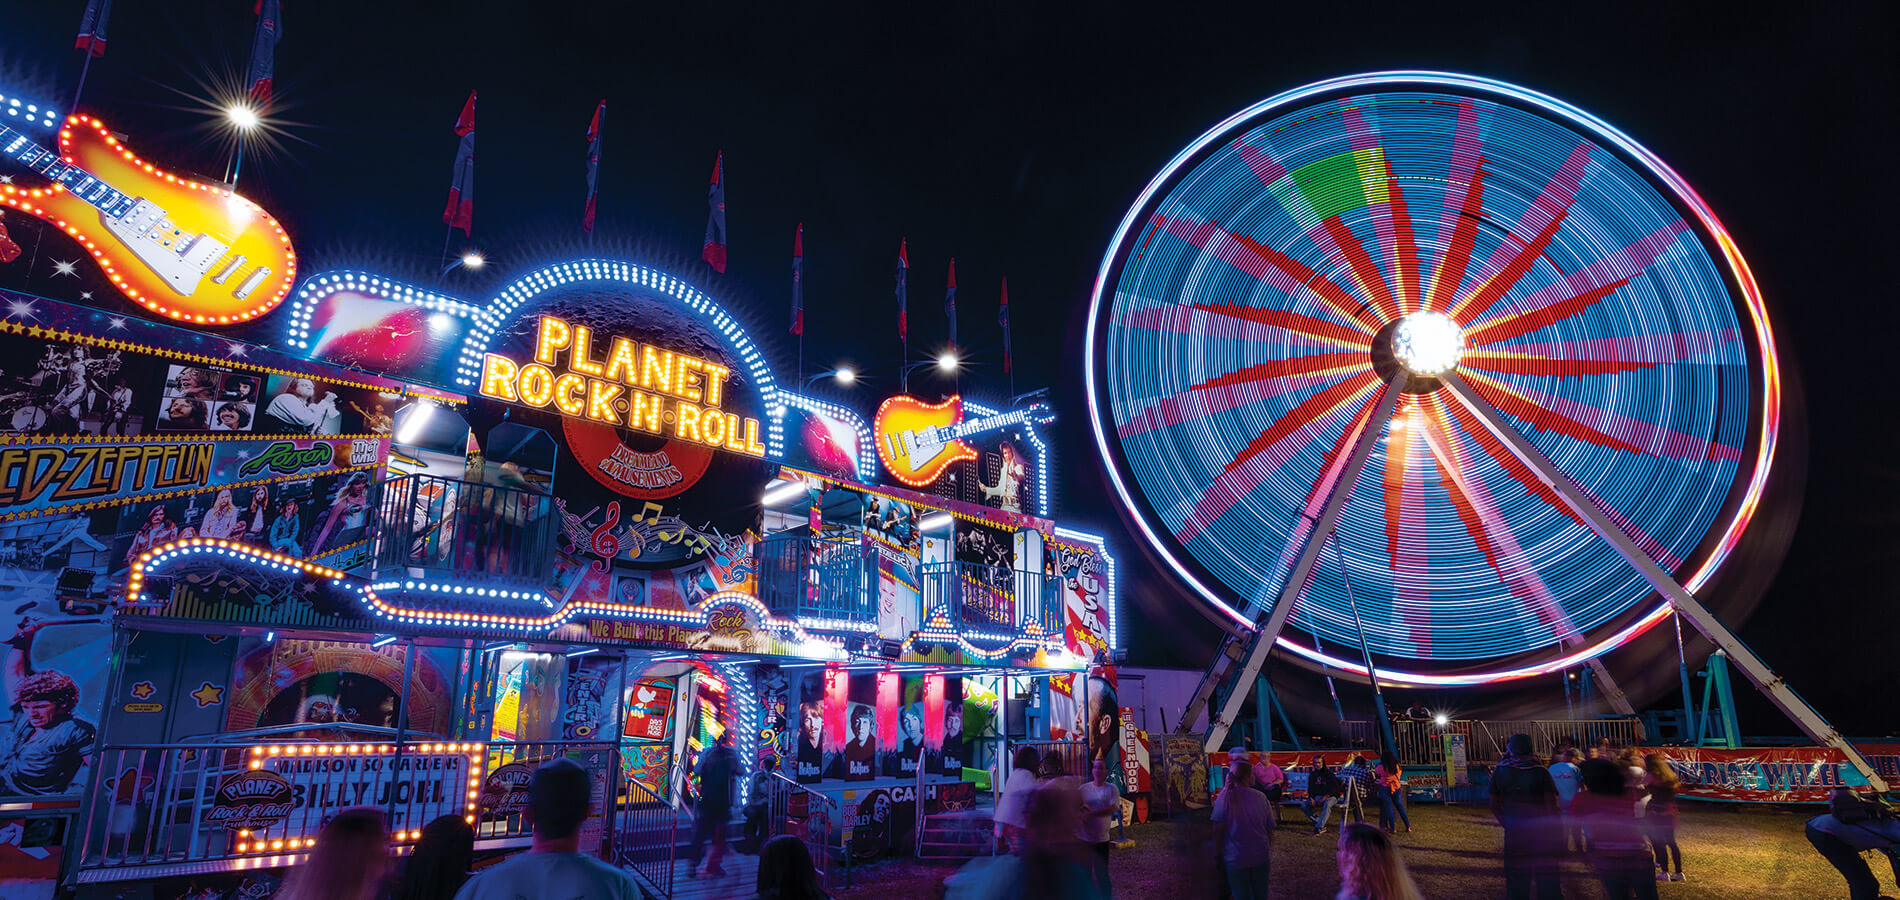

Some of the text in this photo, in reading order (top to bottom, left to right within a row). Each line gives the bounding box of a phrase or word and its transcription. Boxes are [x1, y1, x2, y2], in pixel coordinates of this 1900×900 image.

[537, 314, 729, 408] PLANET
[611, 443, 671, 470] DREAMLAND
[0, 445, 214, 503] ED-ZEPPELIN
[599, 458, 684, 490] AMUSEMENTS
[1061, 548, 1081, 574] God
[1067, 577, 1080, 590] the
[1082, 575, 1102, 634] USA
[591, 619, 609, 637] We
[613, 621, 641, 640] Built
[643, 625, 665, 641] this
[705, 610, 746, 632] Rock
[574, 682, 590, 721] ENTER
[767, 689, 778, 723] ENTER
[277, 758, 356, 774] MADISON
[362, 757, 383, 774] SQ
[1124, 723, 1140, 793] GREENWOOD
[224, 779, 284, 797] PLANET
[1760, 761, 1847, 789] WHEEL
[292, 779, 446, 809] BILLY JOEL
[891, 785, 937, 803] CAH
[209, 803, 293, 820] Rock & Roll
[842, 806, 856, 816] BOB
[842, 815, 872, 827] MARLEY
